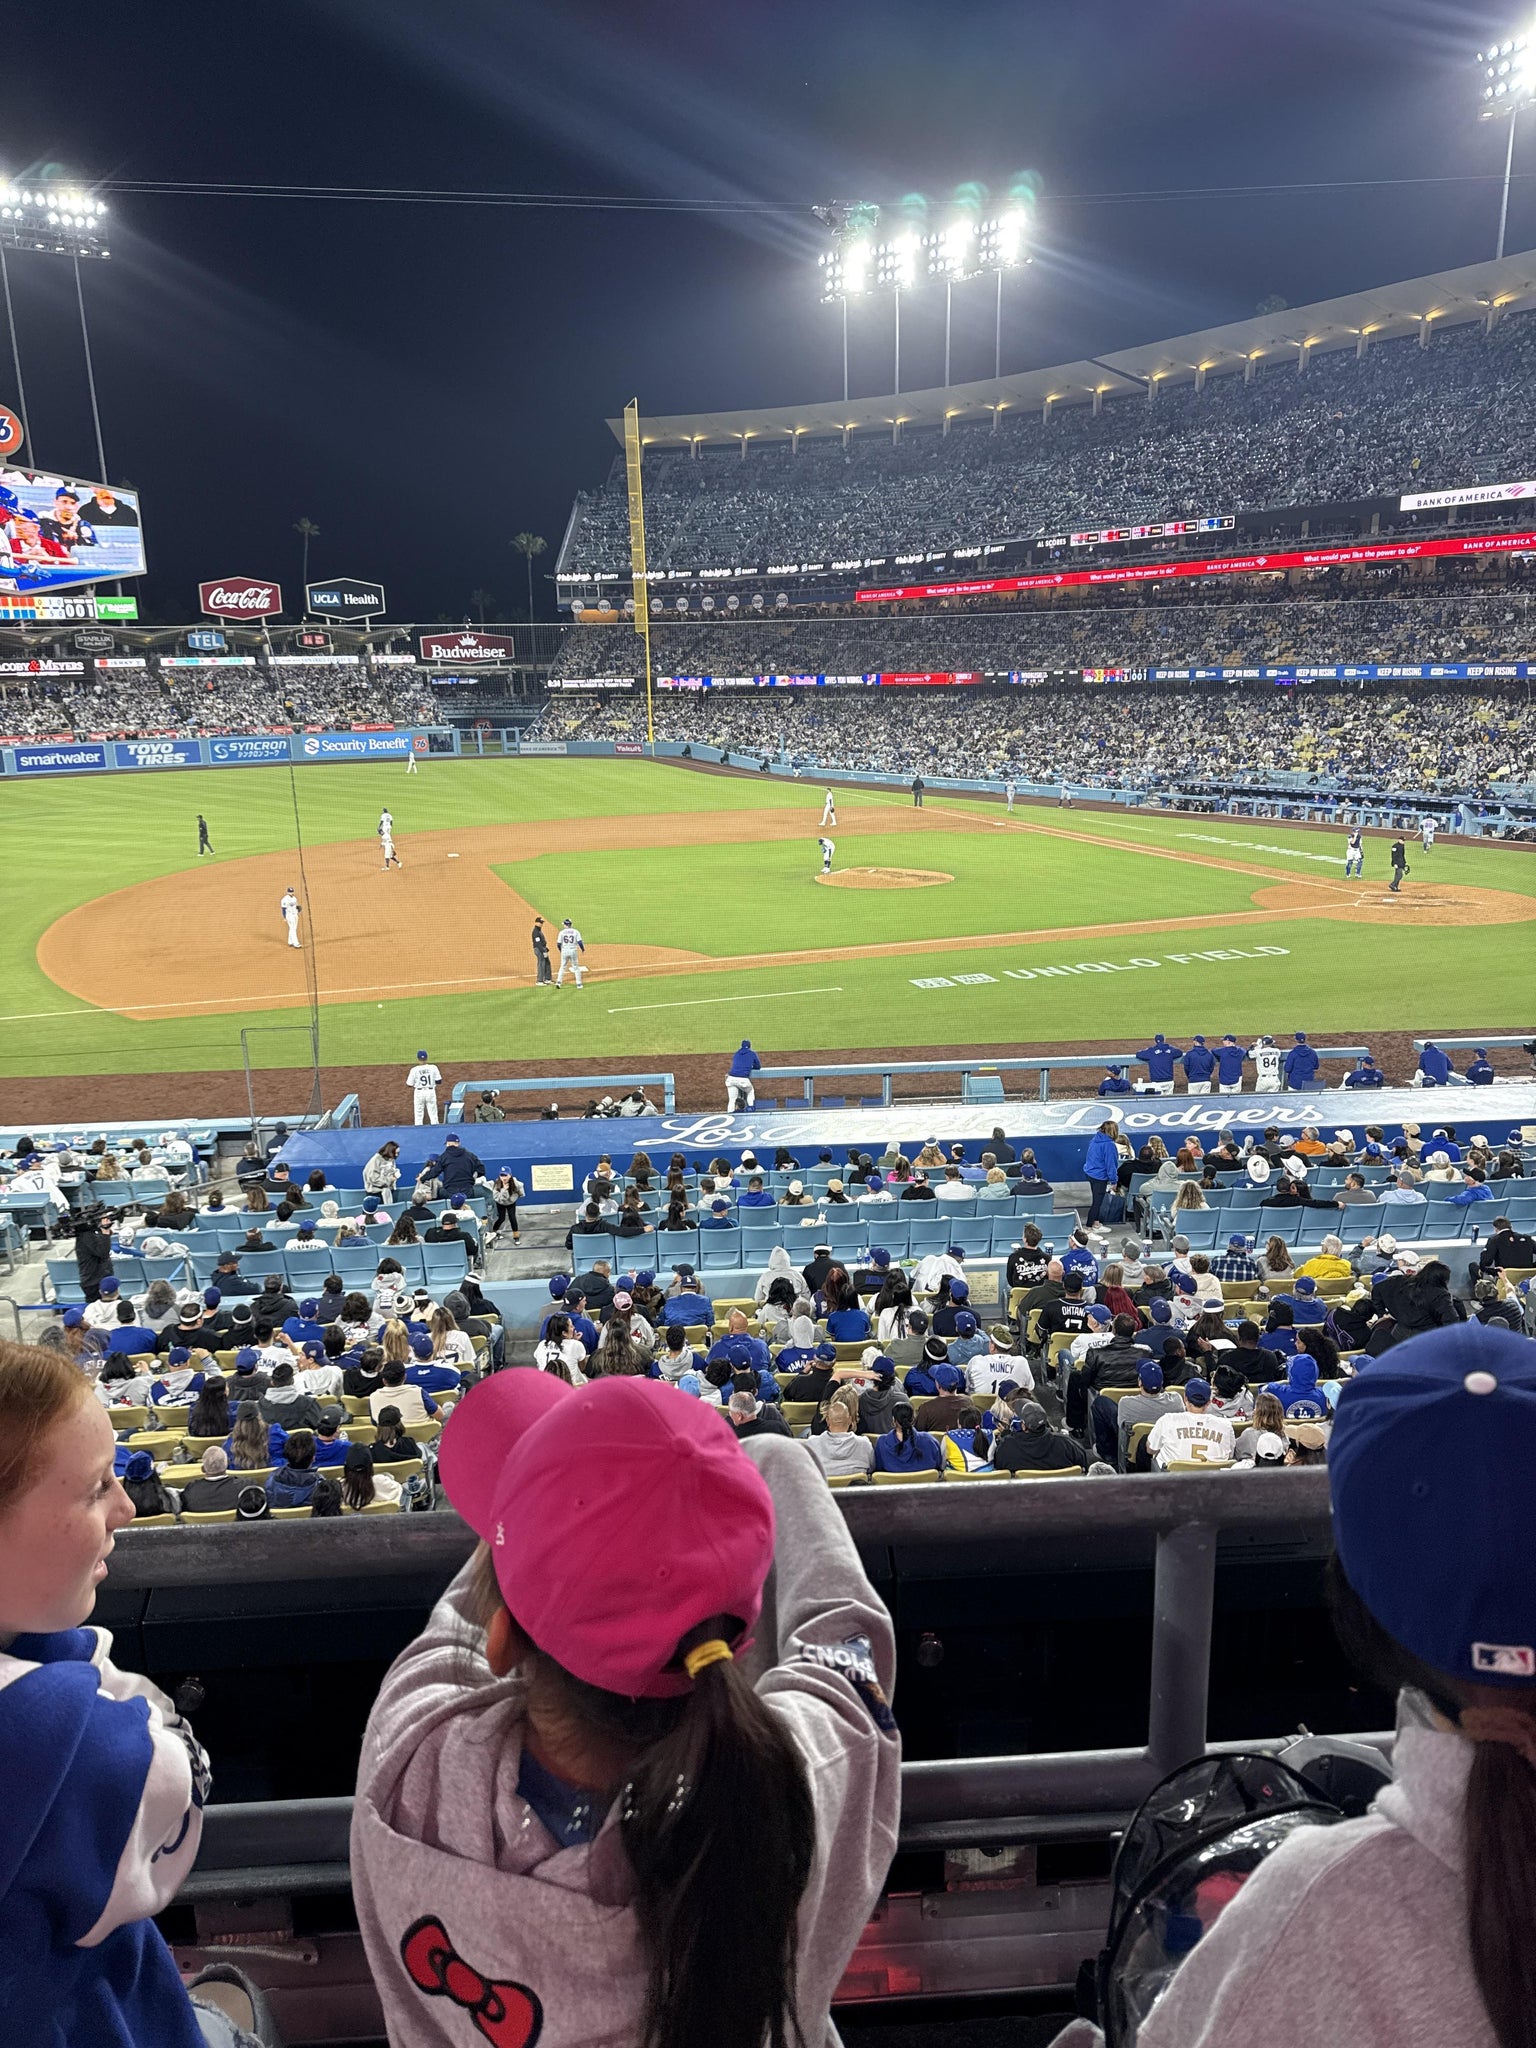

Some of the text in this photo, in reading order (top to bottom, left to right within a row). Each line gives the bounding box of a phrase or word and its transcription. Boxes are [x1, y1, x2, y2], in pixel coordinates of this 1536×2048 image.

[0, 416, 13, 442] 6
[1417, 491, 1503, 507] BANK OF AMERICA
[1464, 539, 1530, 549] BANK OF AMERICA
[1303, 555, 1320, 563] What
[1321, 553, 1338, 562] would
[1339, 554, 1351, 562] you
[1376, 550, 1396, 558] power
[1230, 561, 1255, 569] AMERICA
[313, 593, 379, 605] UCLA Health
[191, 635, 221, 647] TEL
[0, 662, 30, 673] COBY
[40, 659, 85, 671] MEYERS
[1377, 667, 1422, 676] KEEP ON RISING
[1466, 666, 1517, 675] KEEP ON RISING
[127, 743, 174, 754] TOYO
[229, 740, 287, 751] SYNCRON
[321, 737, 407, 752] Security Benefit
[415, 739, 426, 748] 76
[616, 744, 642, 753] Yakult
[20, 751, 101, 767] smartwater
[136, 753, 186, 766] TIRES
[563, 935, 575, 944] 63
[1002, 945, 1292, 979] UNIQLO FIELD
[1263, 1057, 1277, 1068] 84
[420, 1075, 431, 1086] 91
[632, 1114, 757, 1148] Los
[1044, 1102, 1324, 1131] Dodgers
[32, 1176, 44, 1190] 17
[1065, 1318, 1083, 1330] 17
[257, 1359, 278, 1368] EMAN
[787, 1359, 809, 1373] YAMA
[989, 1362, 1015, 1374] MUNCY
[1298, 1407, 1311, 1418] LA
[1176, 1427, 1223, 1444] FREEMAN
[1191, 1444, 1208, 1462] 5
[802, 1644, 873, 1673] PIONS
